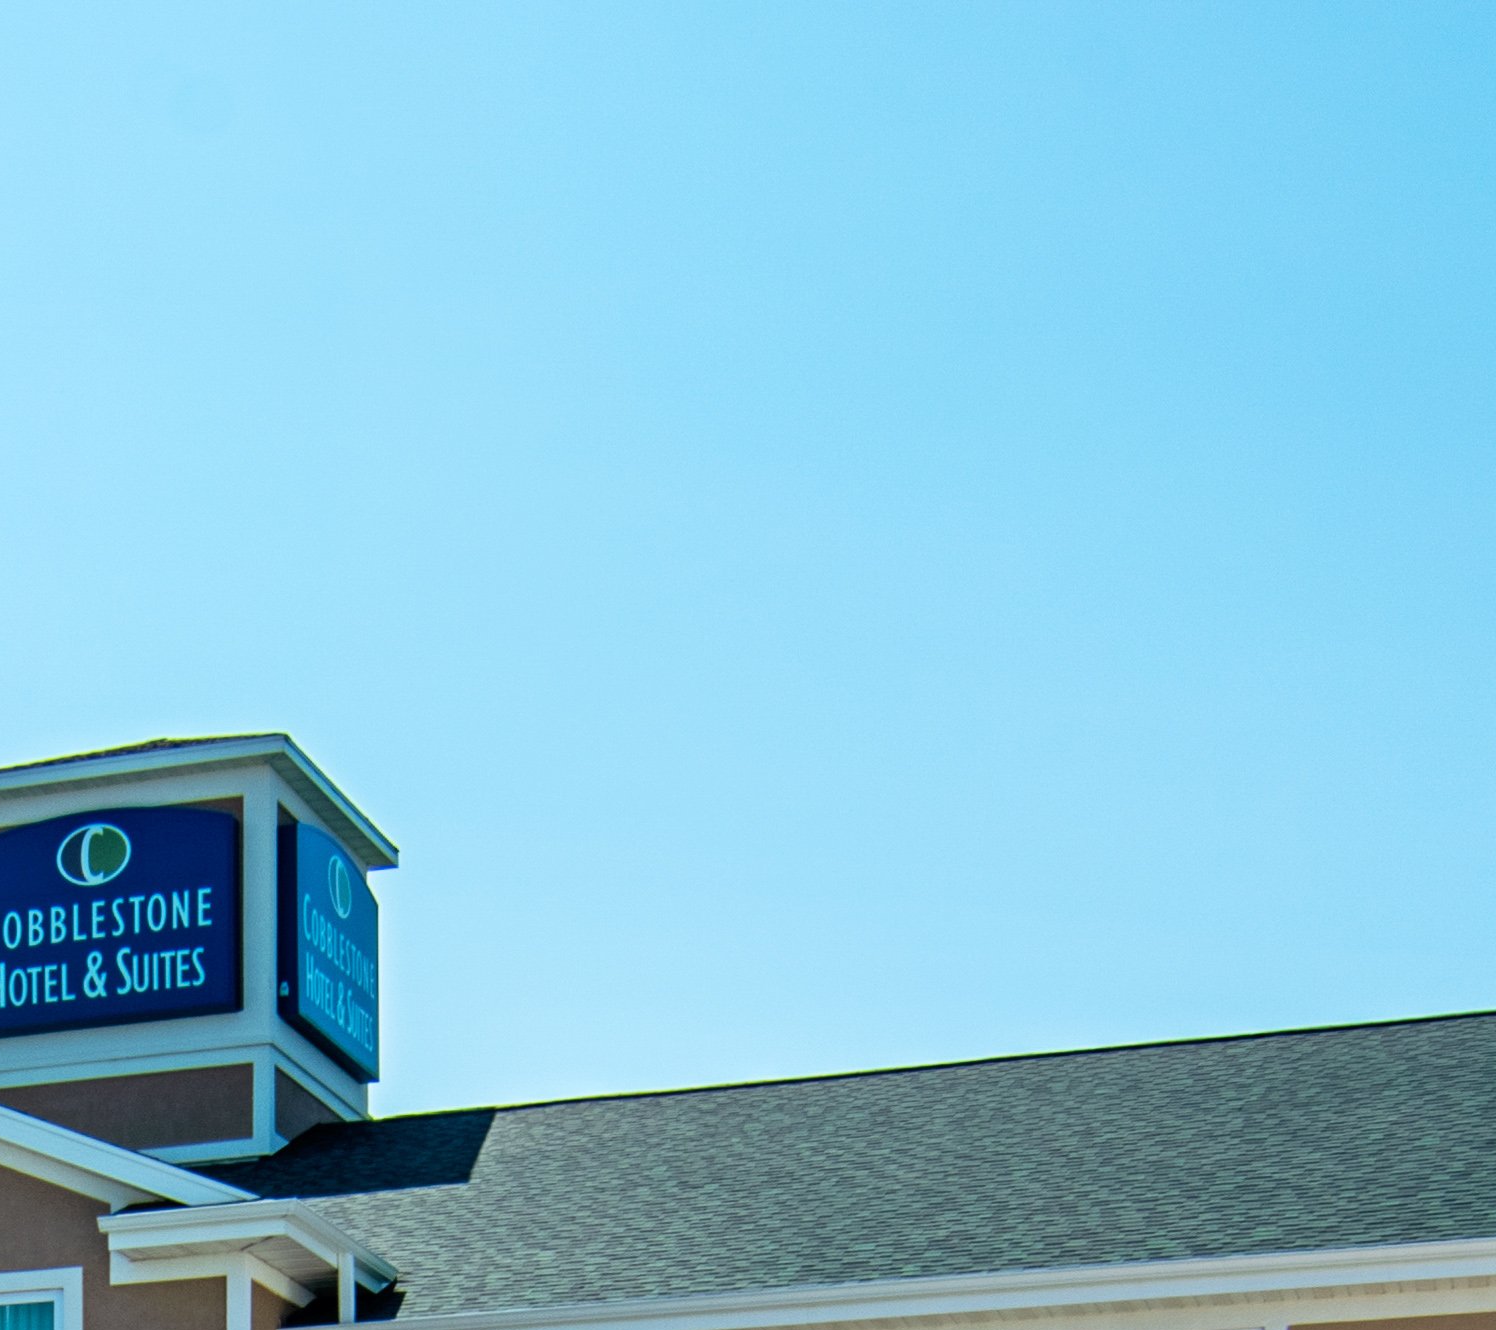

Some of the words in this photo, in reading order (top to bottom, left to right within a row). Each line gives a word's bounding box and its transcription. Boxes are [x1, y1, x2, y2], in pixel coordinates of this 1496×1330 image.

[83, 950, 107, 999] &
[116, 946, 206, 996] SUITES
[303, 893, 375, 999] COBBLESTONE
[306, 951, 335, 1020] HOTEL
[338, 981, 346, 1029] &
[347, 988, 374, 1053] SUITES
